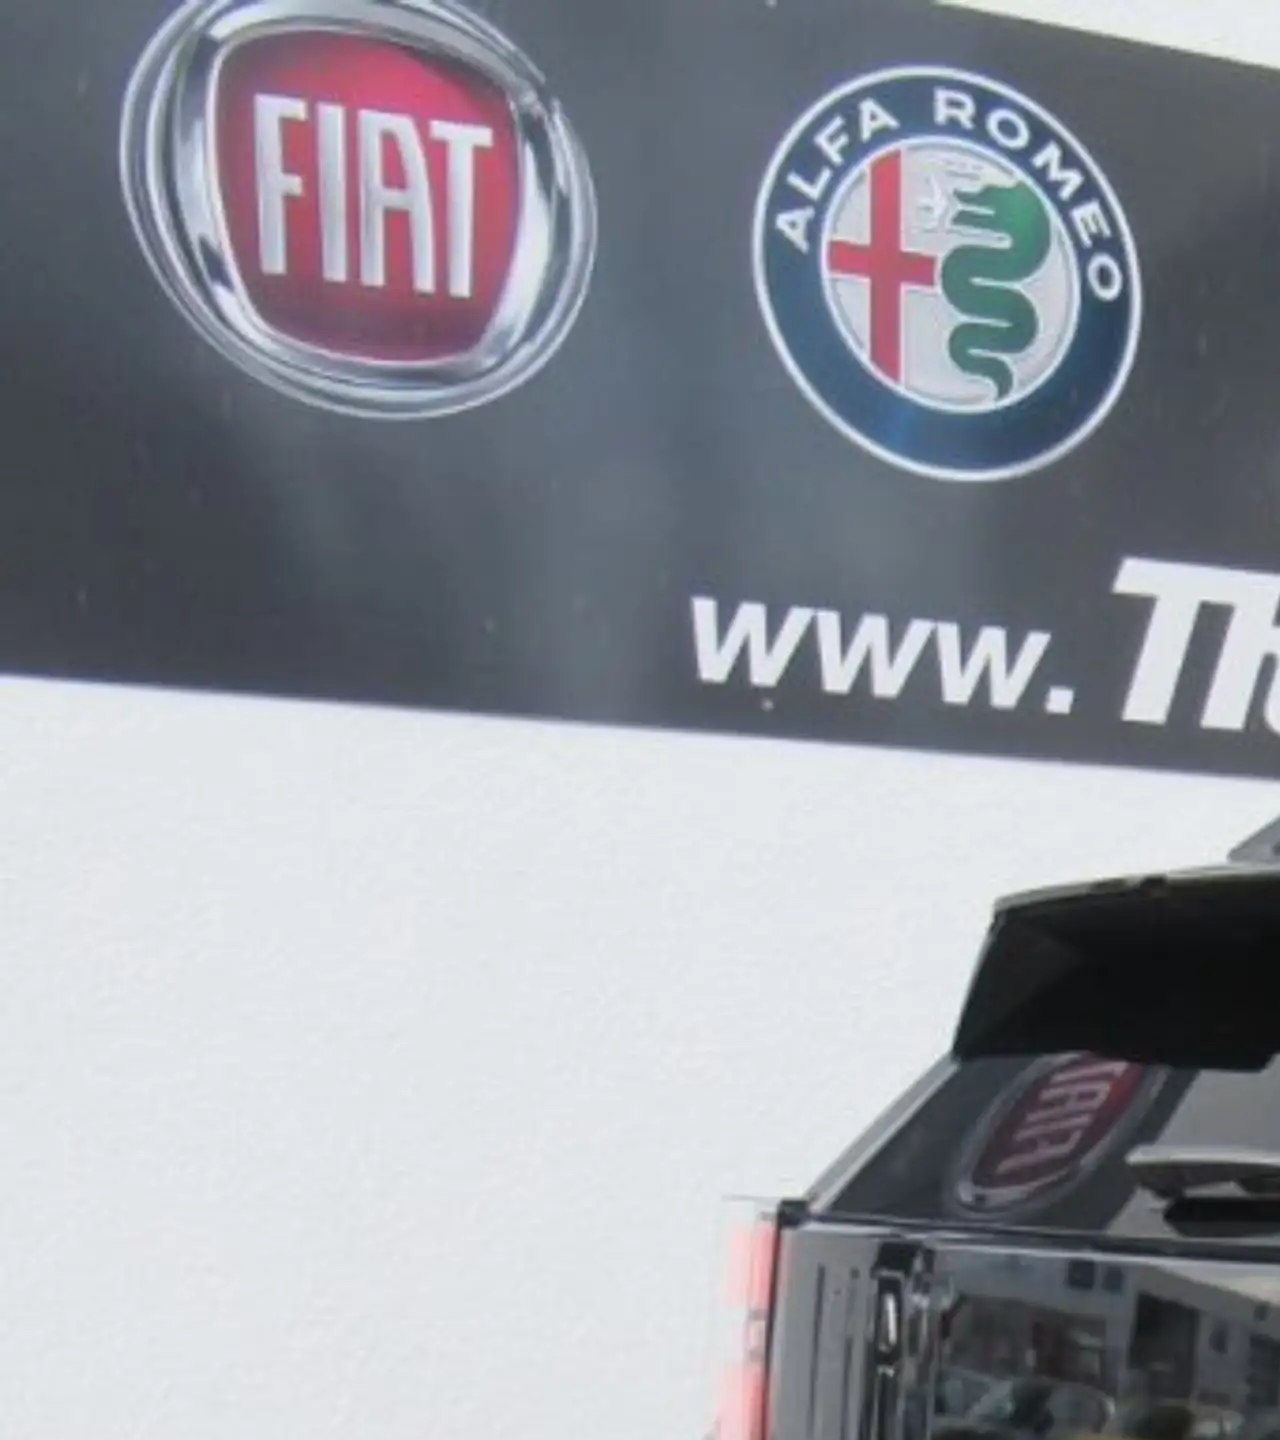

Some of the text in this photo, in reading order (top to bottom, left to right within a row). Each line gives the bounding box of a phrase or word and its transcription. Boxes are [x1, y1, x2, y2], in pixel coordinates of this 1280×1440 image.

[254, 93, 493, 298] FIAT
[776, 88, 1122, 301] ALFA ROMEO
